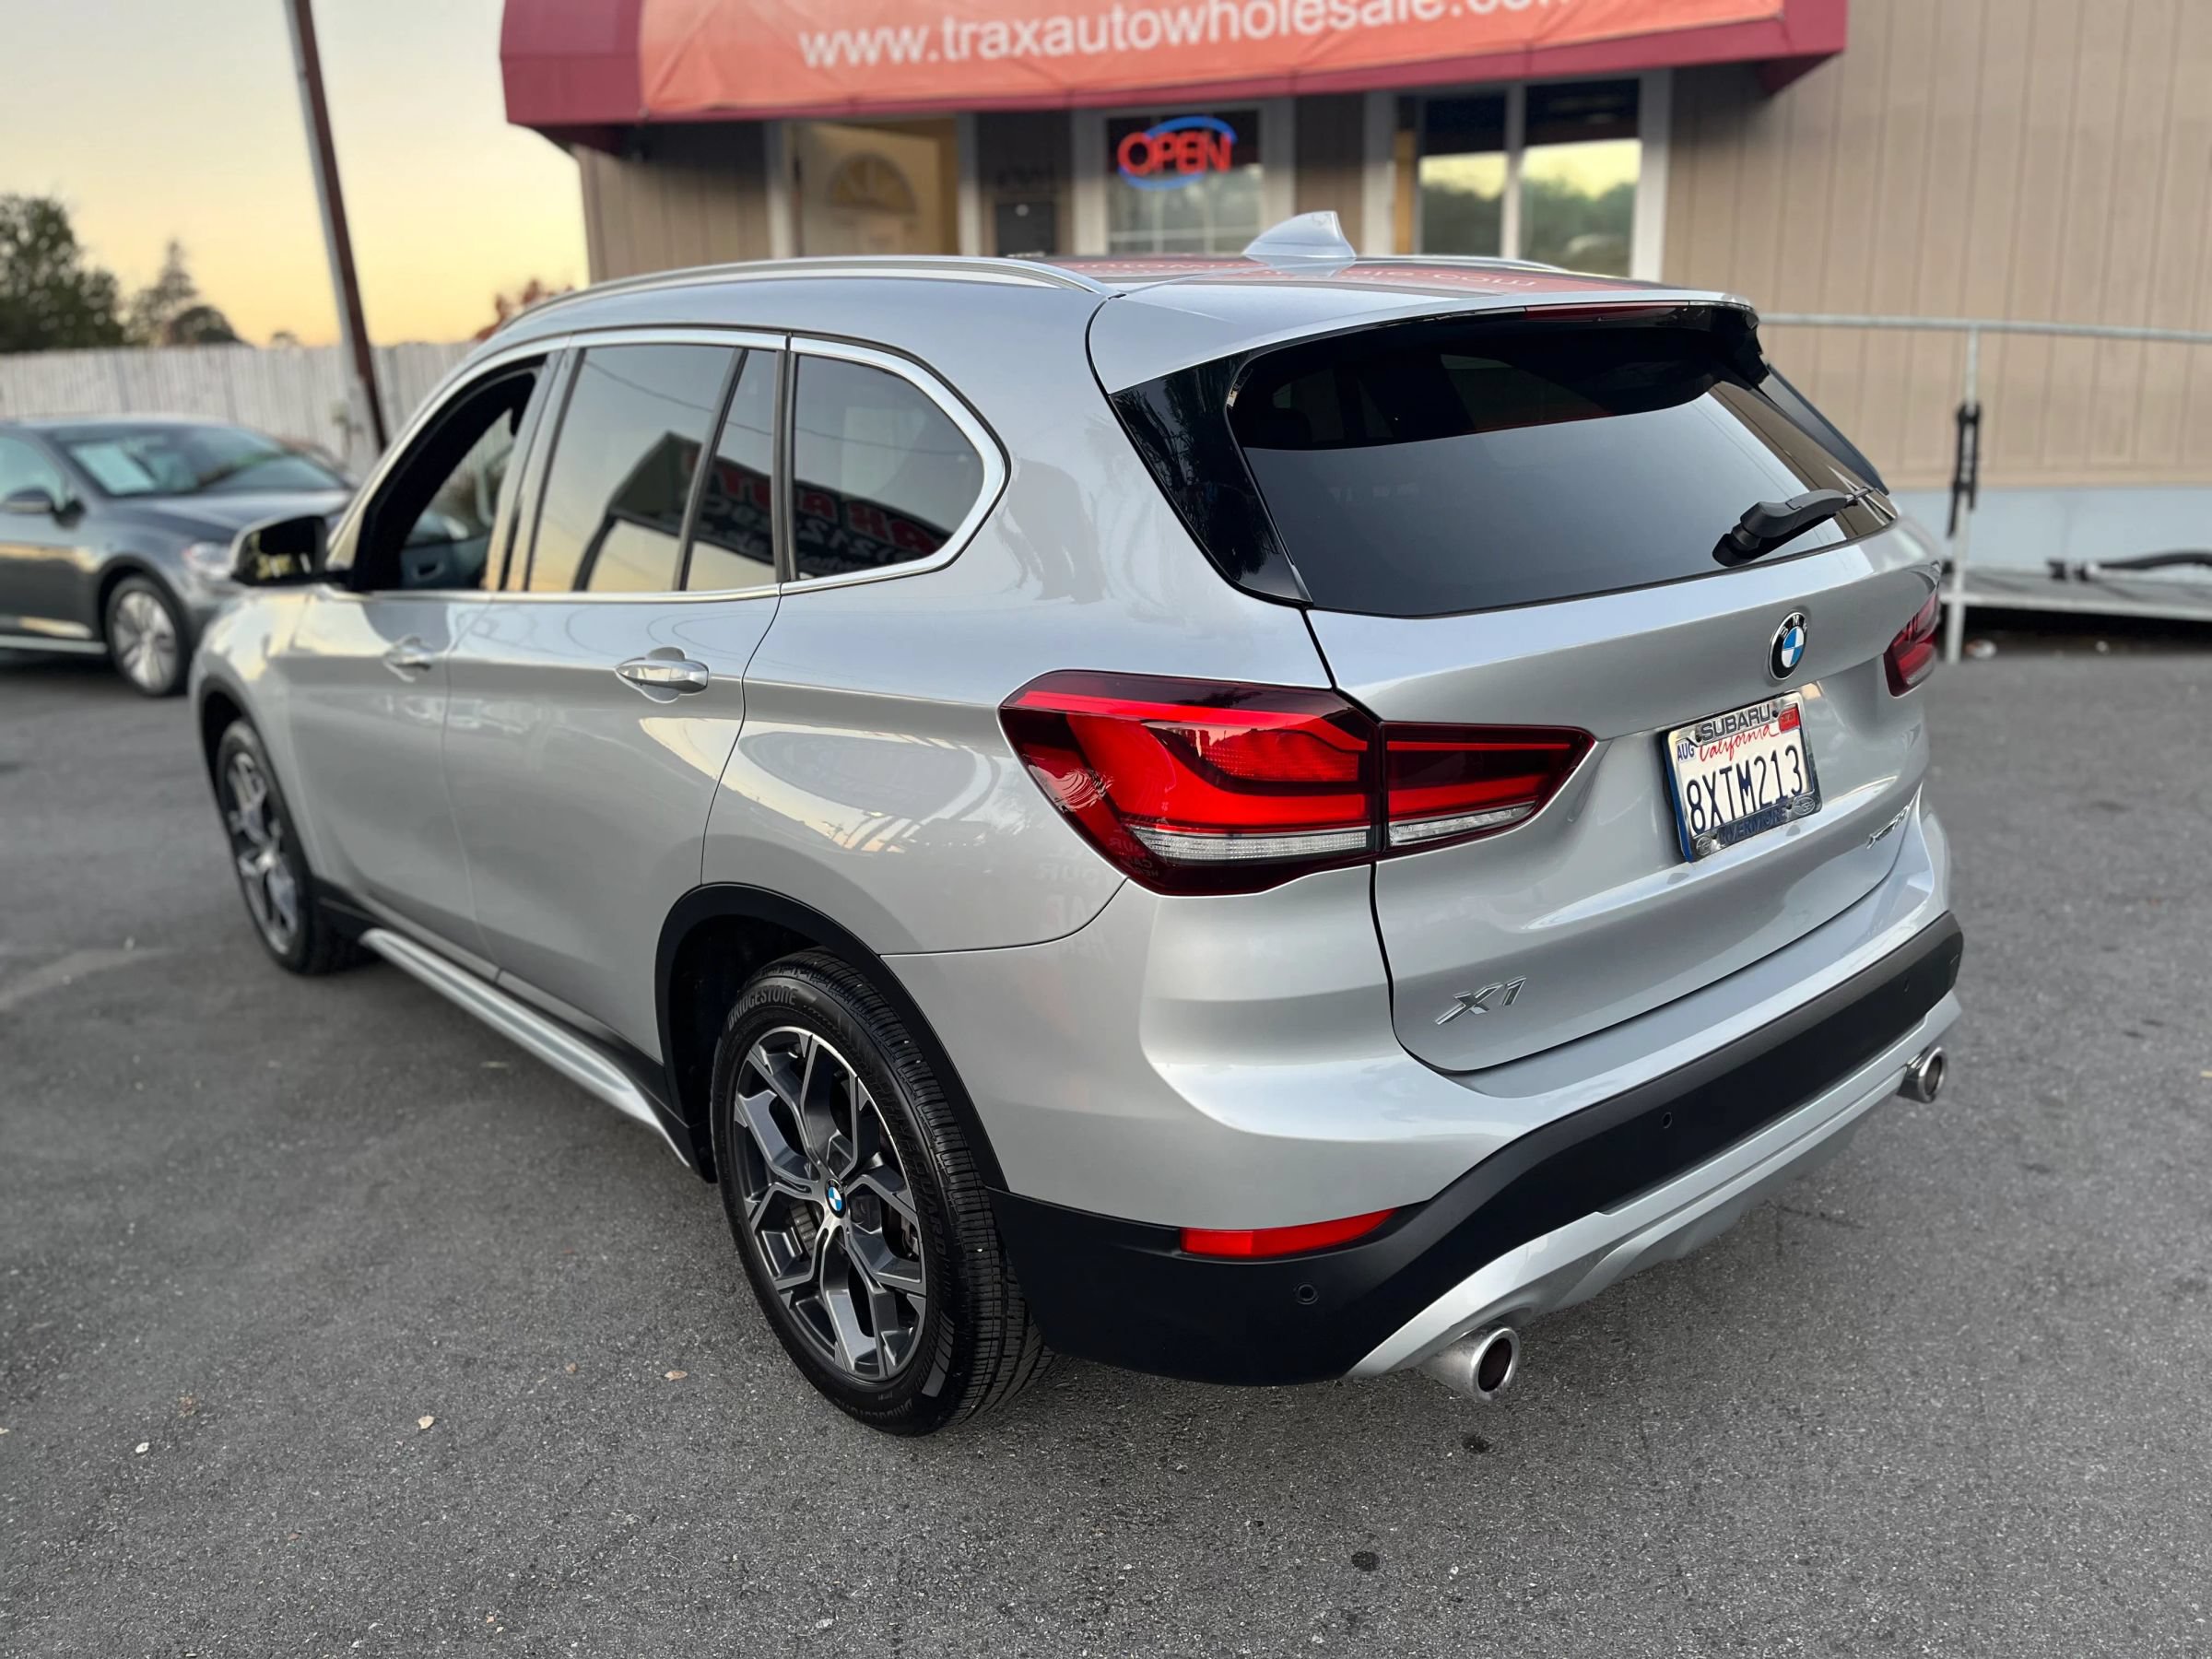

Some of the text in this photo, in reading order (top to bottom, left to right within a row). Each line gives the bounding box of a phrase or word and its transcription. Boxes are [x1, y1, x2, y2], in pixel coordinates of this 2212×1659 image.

[1117, 131, 1232, 176] OPEN
[1699, 724, 1780, 762] California
[1700, 703, 1771, 741] SUBARU
[1677, 743, 1695, 761] AUG
[1686, 744, 1804, 835] 8XTM213
[728, 984, 798, 1031] BRIDGESTONE
[1435, 976, 1526, 1025] X1
